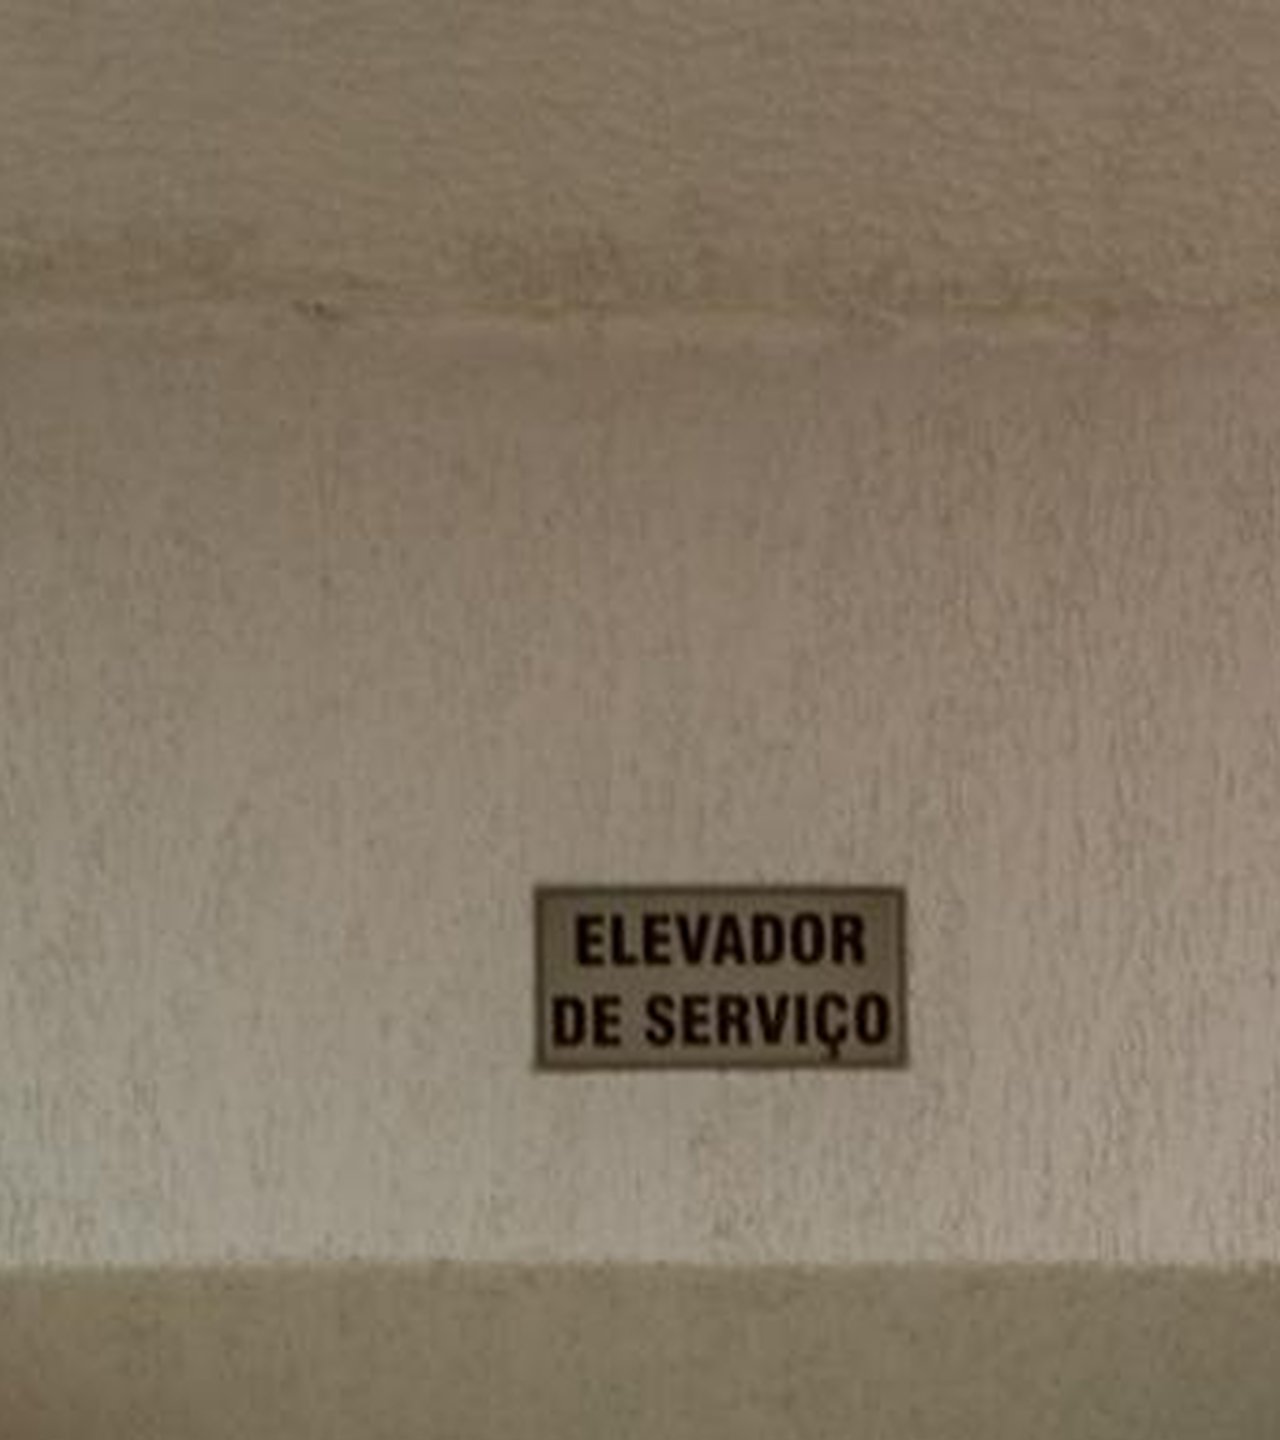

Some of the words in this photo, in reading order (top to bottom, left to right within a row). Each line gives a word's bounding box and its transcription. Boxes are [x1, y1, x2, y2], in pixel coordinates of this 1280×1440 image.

[575, 912, 866, 967] ELEVADOR
[550, 994, 622, 1048] DE
[644, 991, 892, 1060] SERVIÇO
